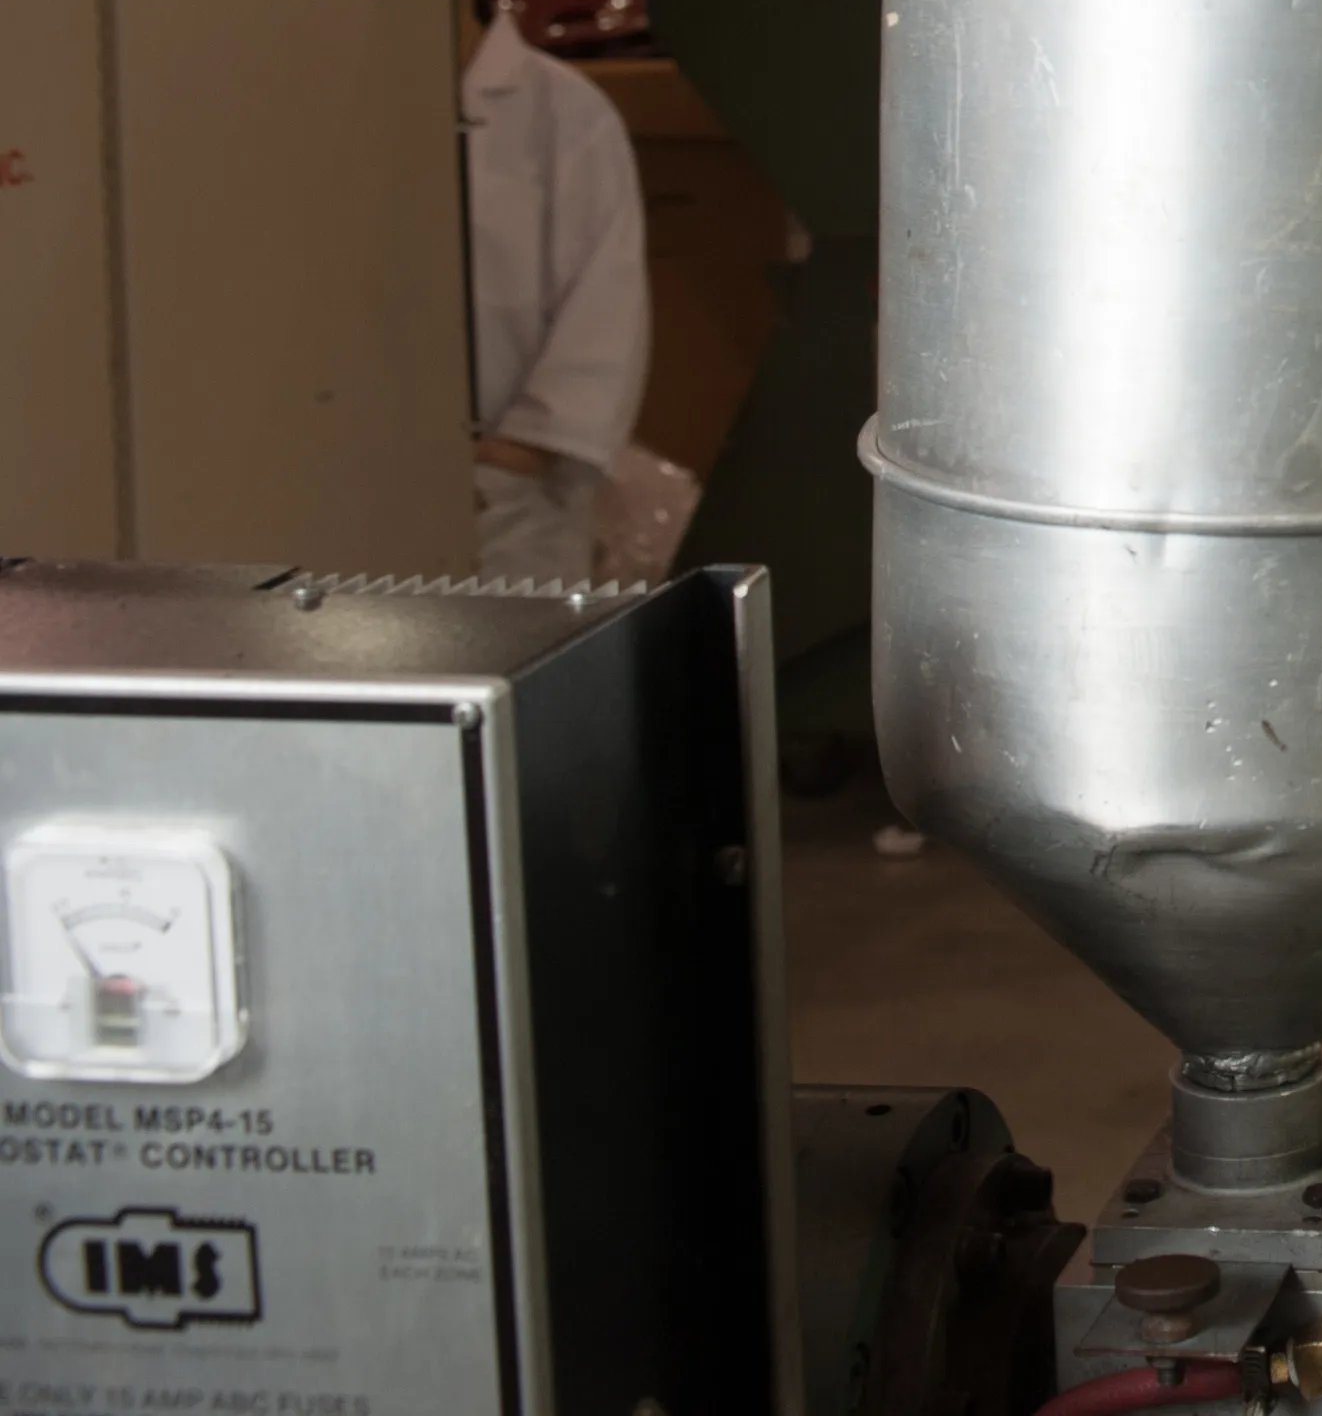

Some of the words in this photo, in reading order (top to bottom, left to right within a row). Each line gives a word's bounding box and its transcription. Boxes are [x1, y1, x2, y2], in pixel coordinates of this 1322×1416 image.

[4, 1100, 124, 1132] MODEL
[134, 1103, 275, 1136] MSP4-15
[139, 1141, 378, 1176] CONTROLLER
[83, 1241, 222, 1300] IMS
[141, 1386, 205, 1411] AMP
